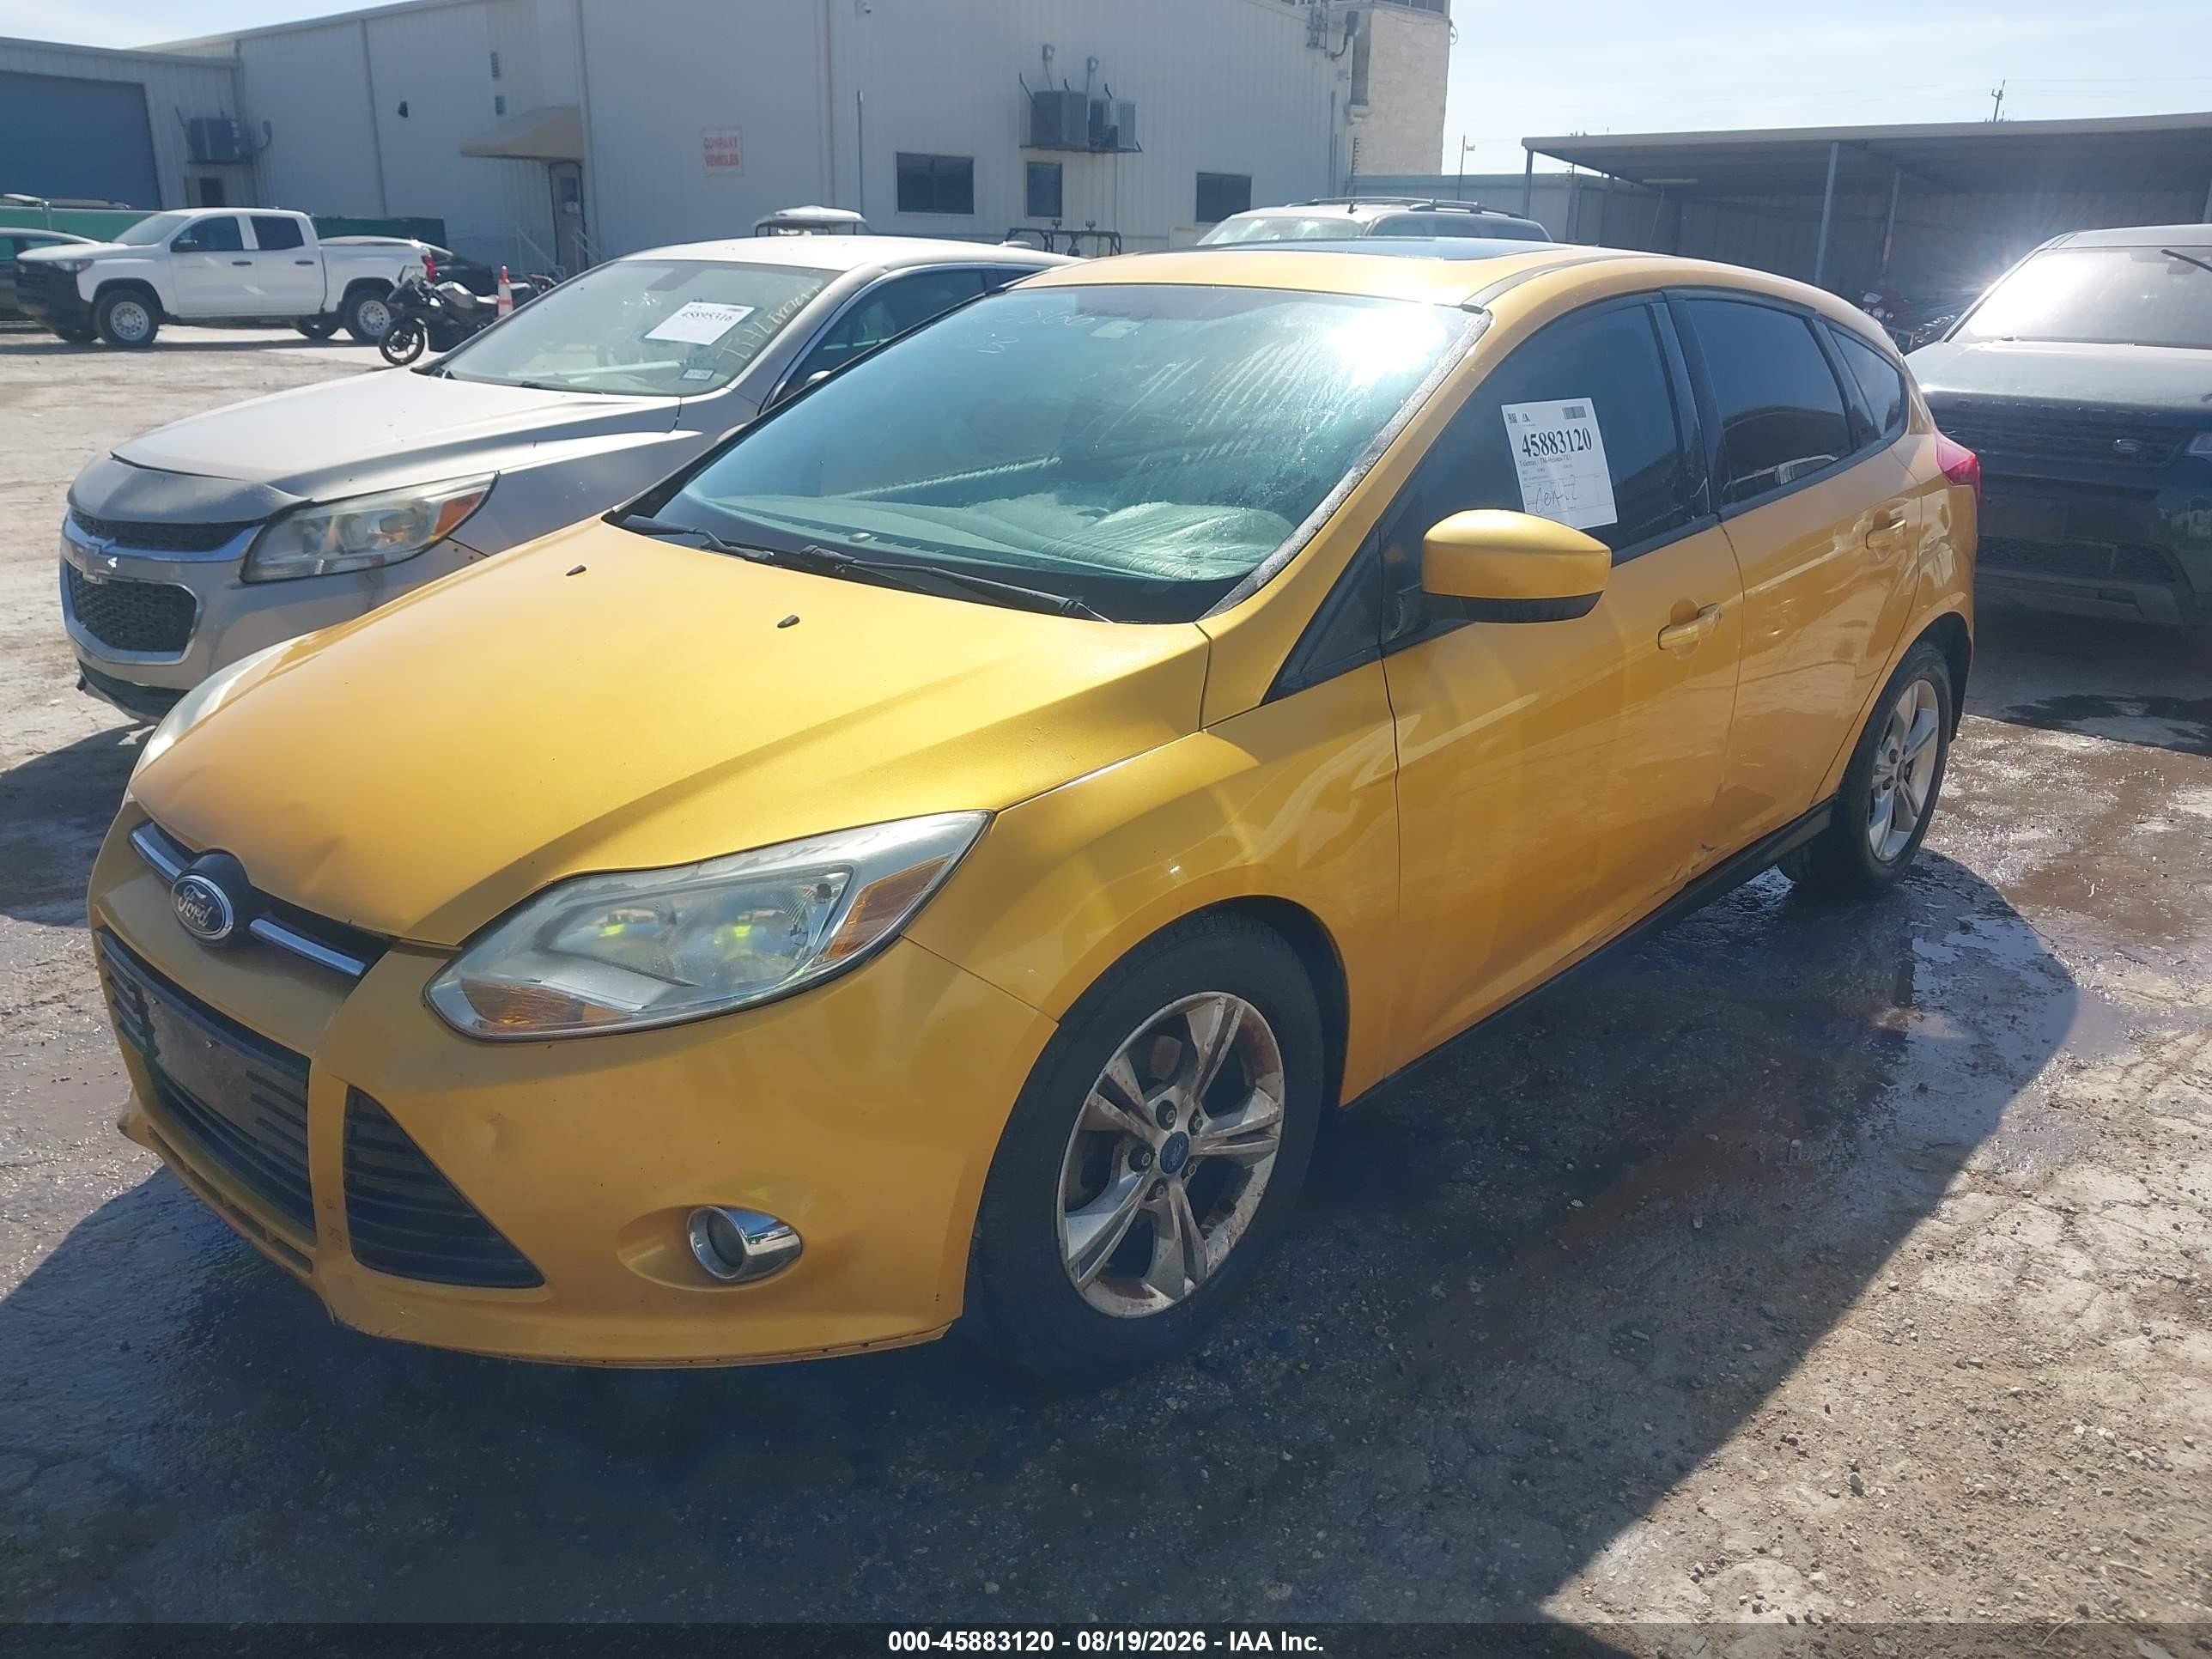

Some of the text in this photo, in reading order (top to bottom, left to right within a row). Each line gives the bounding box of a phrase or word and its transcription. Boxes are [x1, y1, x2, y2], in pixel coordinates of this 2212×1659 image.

[703, 137, 738, 150] COMPANY
[705, 153, 739, 167] VEHICLES
[1522, 427, 1592, 458] 45883120
[178, 884, 214, 927] Ford
